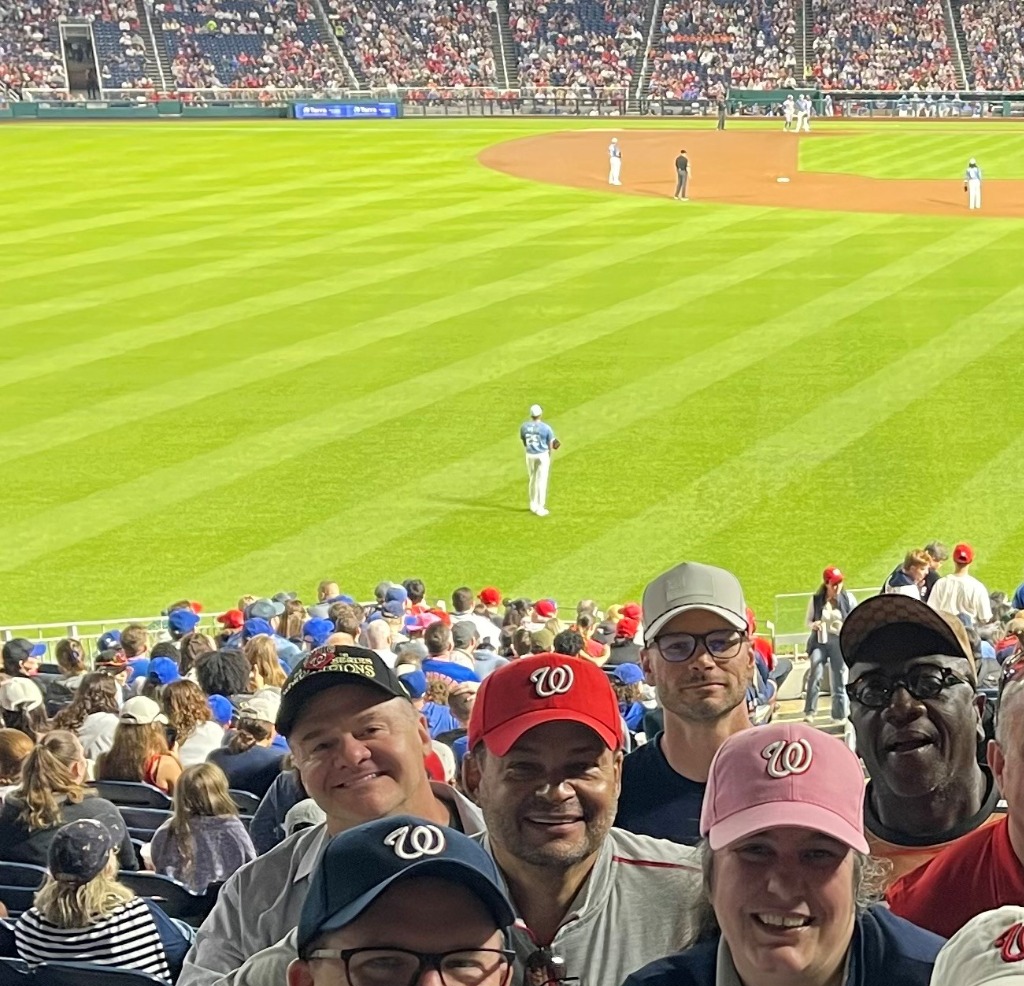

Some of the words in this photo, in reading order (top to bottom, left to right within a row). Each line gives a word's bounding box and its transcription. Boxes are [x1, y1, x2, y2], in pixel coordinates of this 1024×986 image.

[530, 664, 574, 697] W
[761, 738, 813, 779] W
[384, 824, 446, 860] W
